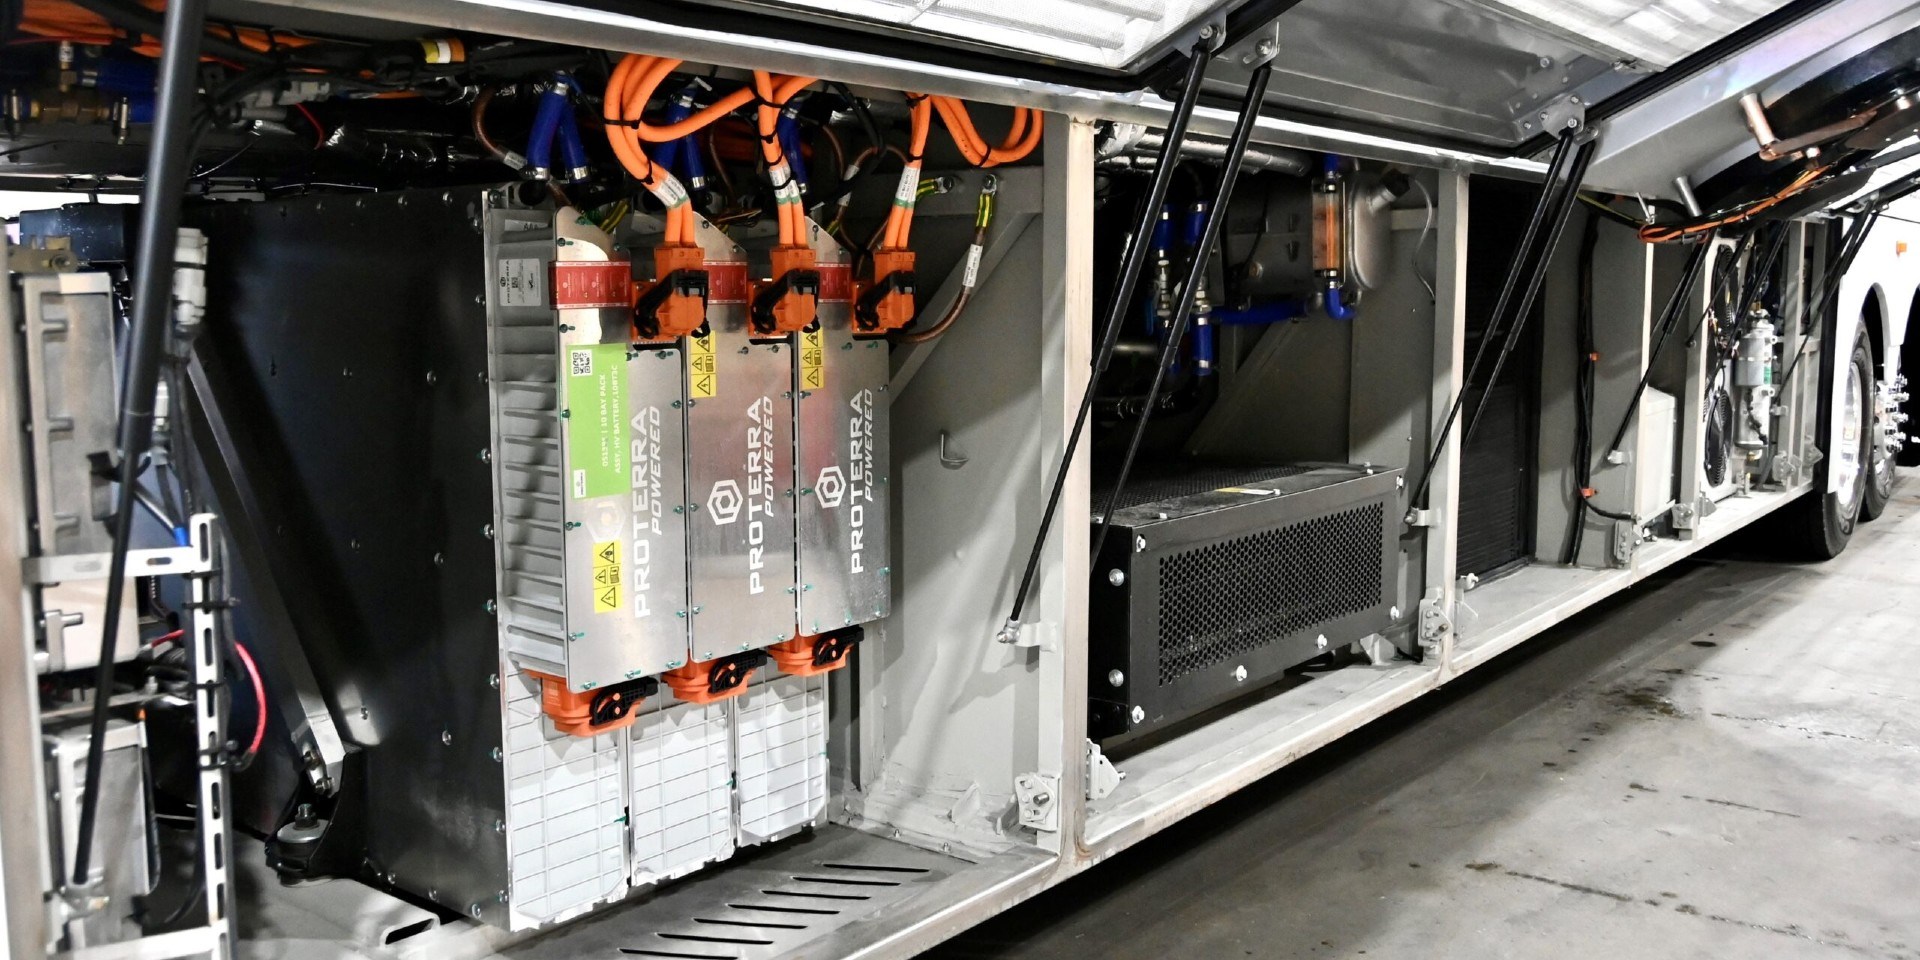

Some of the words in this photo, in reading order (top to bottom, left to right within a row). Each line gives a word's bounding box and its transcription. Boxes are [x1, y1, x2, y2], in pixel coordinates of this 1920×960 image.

[601, 416, 607, 427] 10
[613, 436, 620, 448] HV
[650, 406, 662, 536] POWERED
[763, 395, 774, 517] POWERED
[850, 389, 864, 574] PROTERRA
[864, 388, 873, 502] POWERED
[632, 408, 651, 617] PROTERRA
[747, 398, 764, 594] PROTERRA
